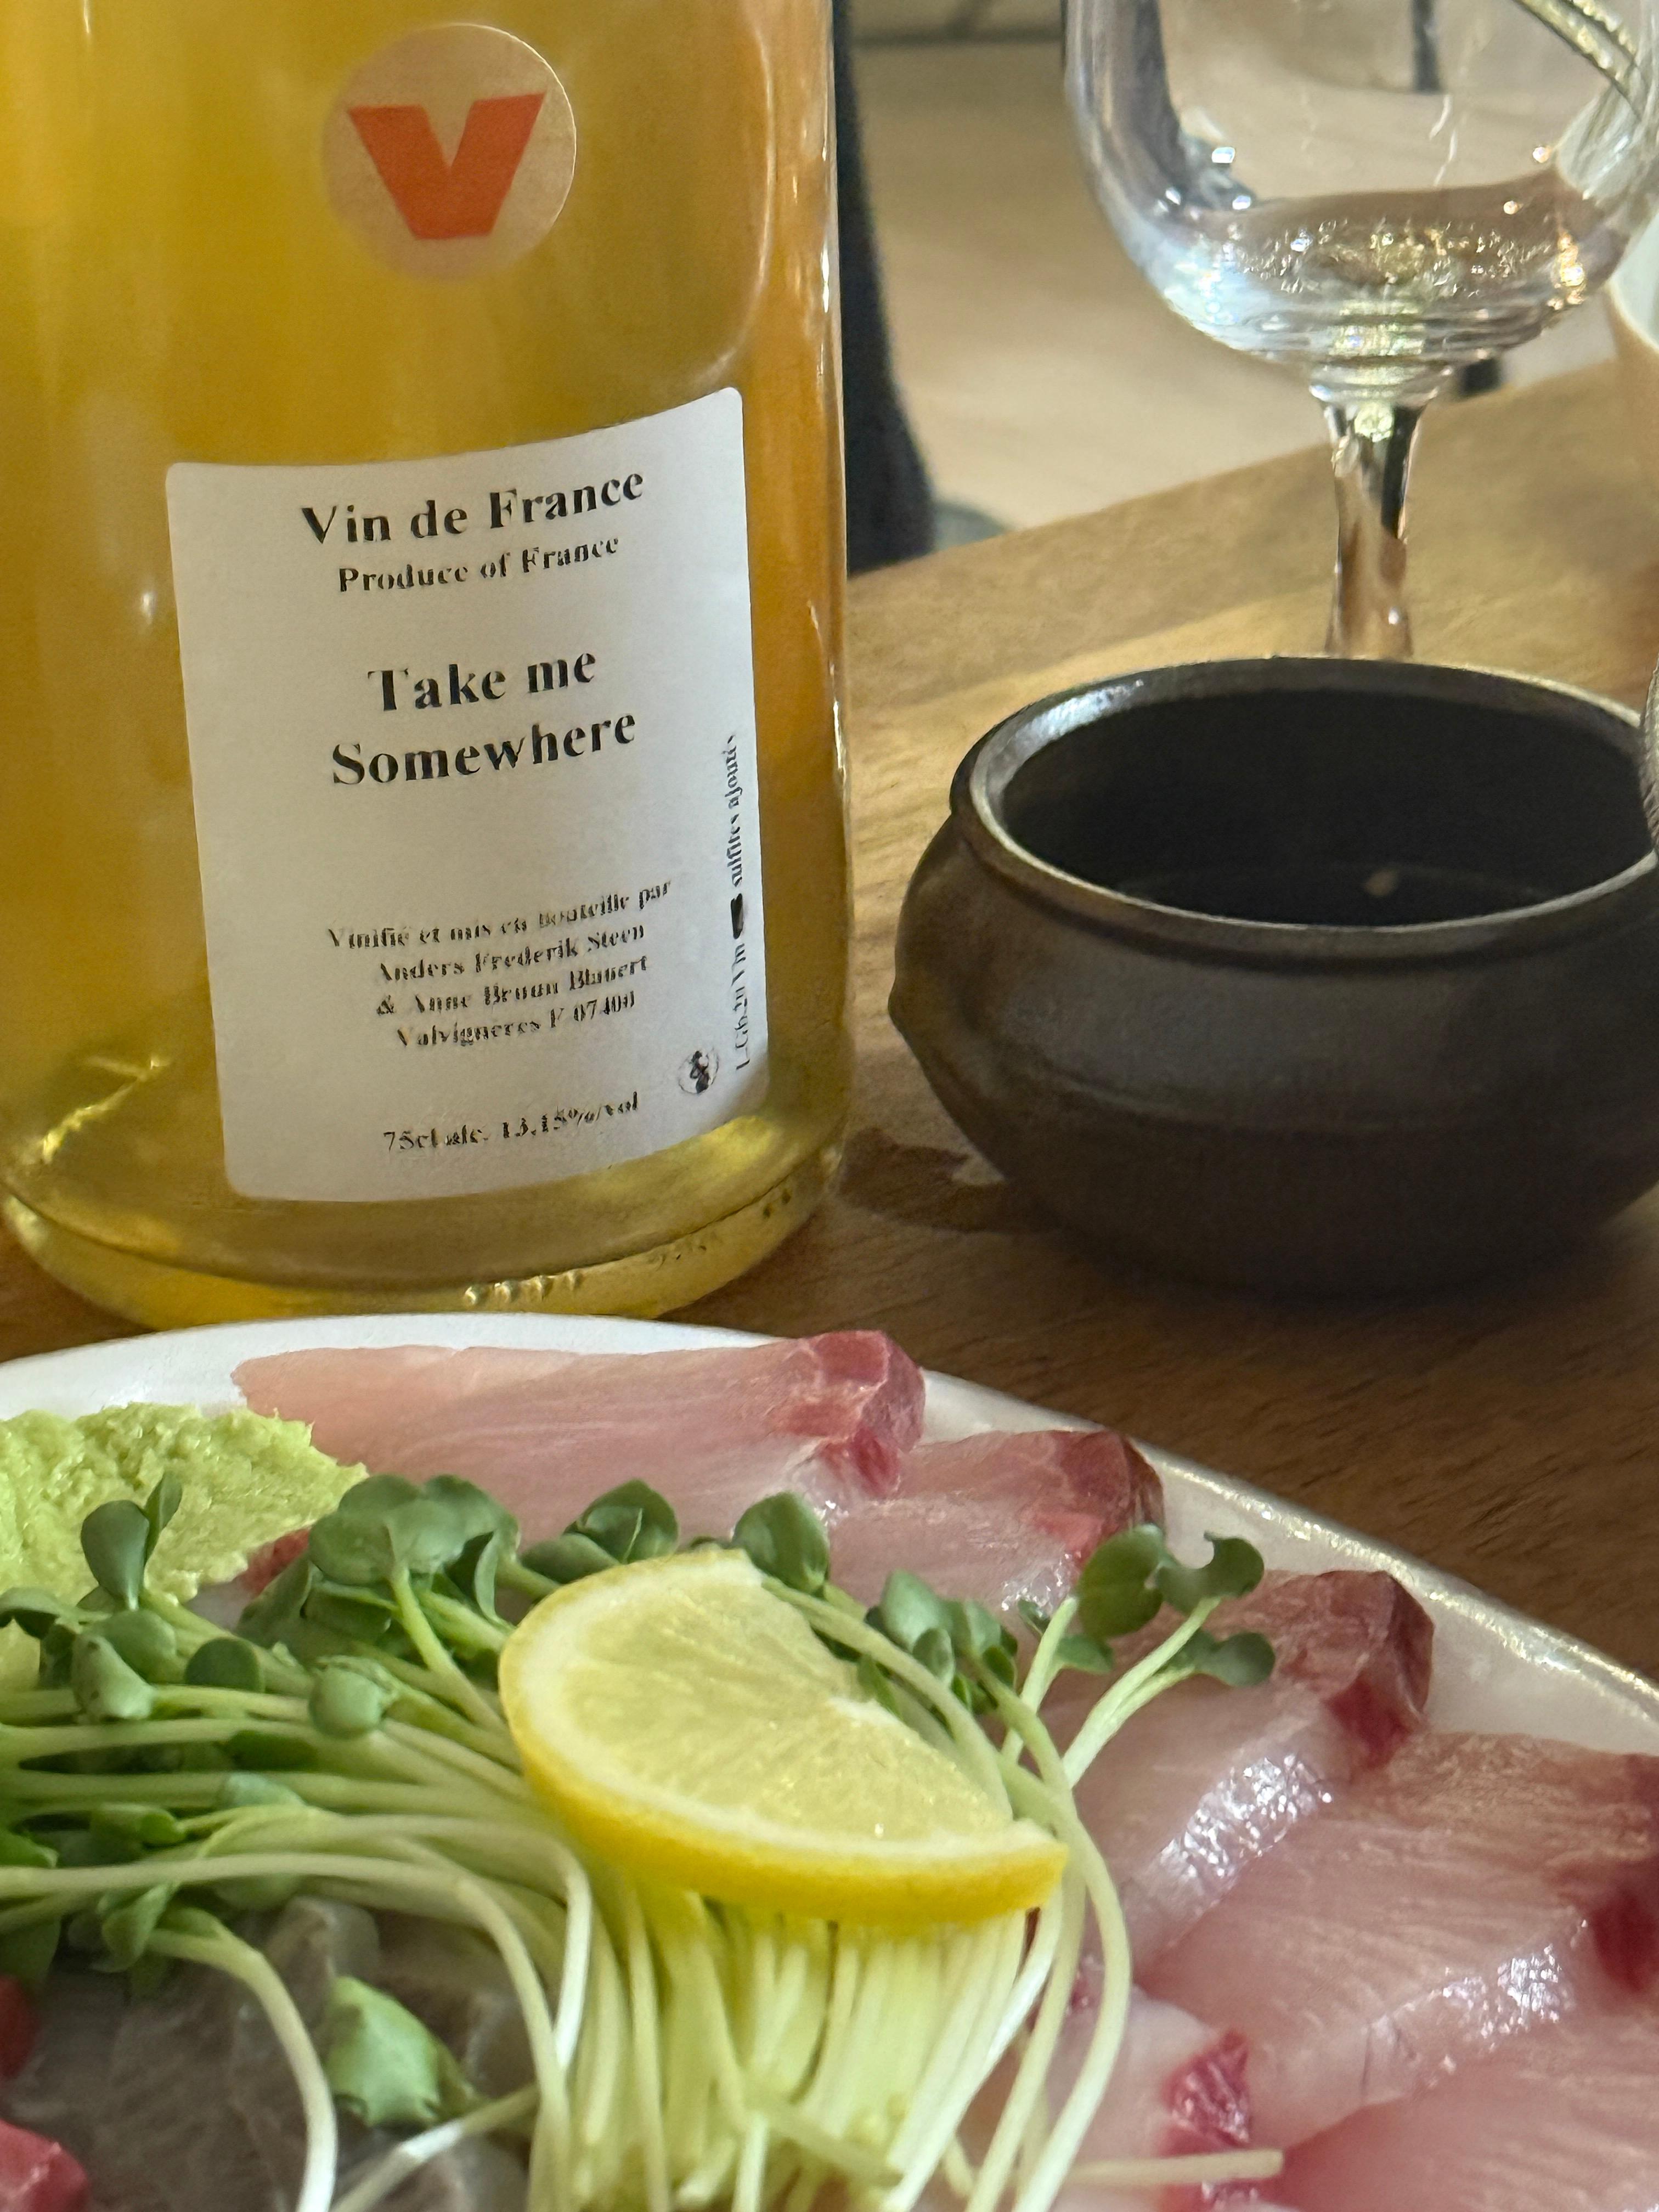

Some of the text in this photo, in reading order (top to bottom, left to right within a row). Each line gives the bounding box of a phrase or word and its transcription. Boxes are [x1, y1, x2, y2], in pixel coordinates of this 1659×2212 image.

[347, 92, 544, 240] V
[302, 472, 644, 544] Vin de France
[338, 537, 619, 592] Produce of France
[367, 652, 596, 712] Take me
[332, 713, 636, 785] Somewhere
[420, 927, 440, 944] et
[450, 922, 491, 940] mis
[639, 881, 671, 912] par
[380, 924, 644, 981] Anders Frederik Steen
[376, 994, 396, 1015] &
[415, 995, 472, 1013] Anne
